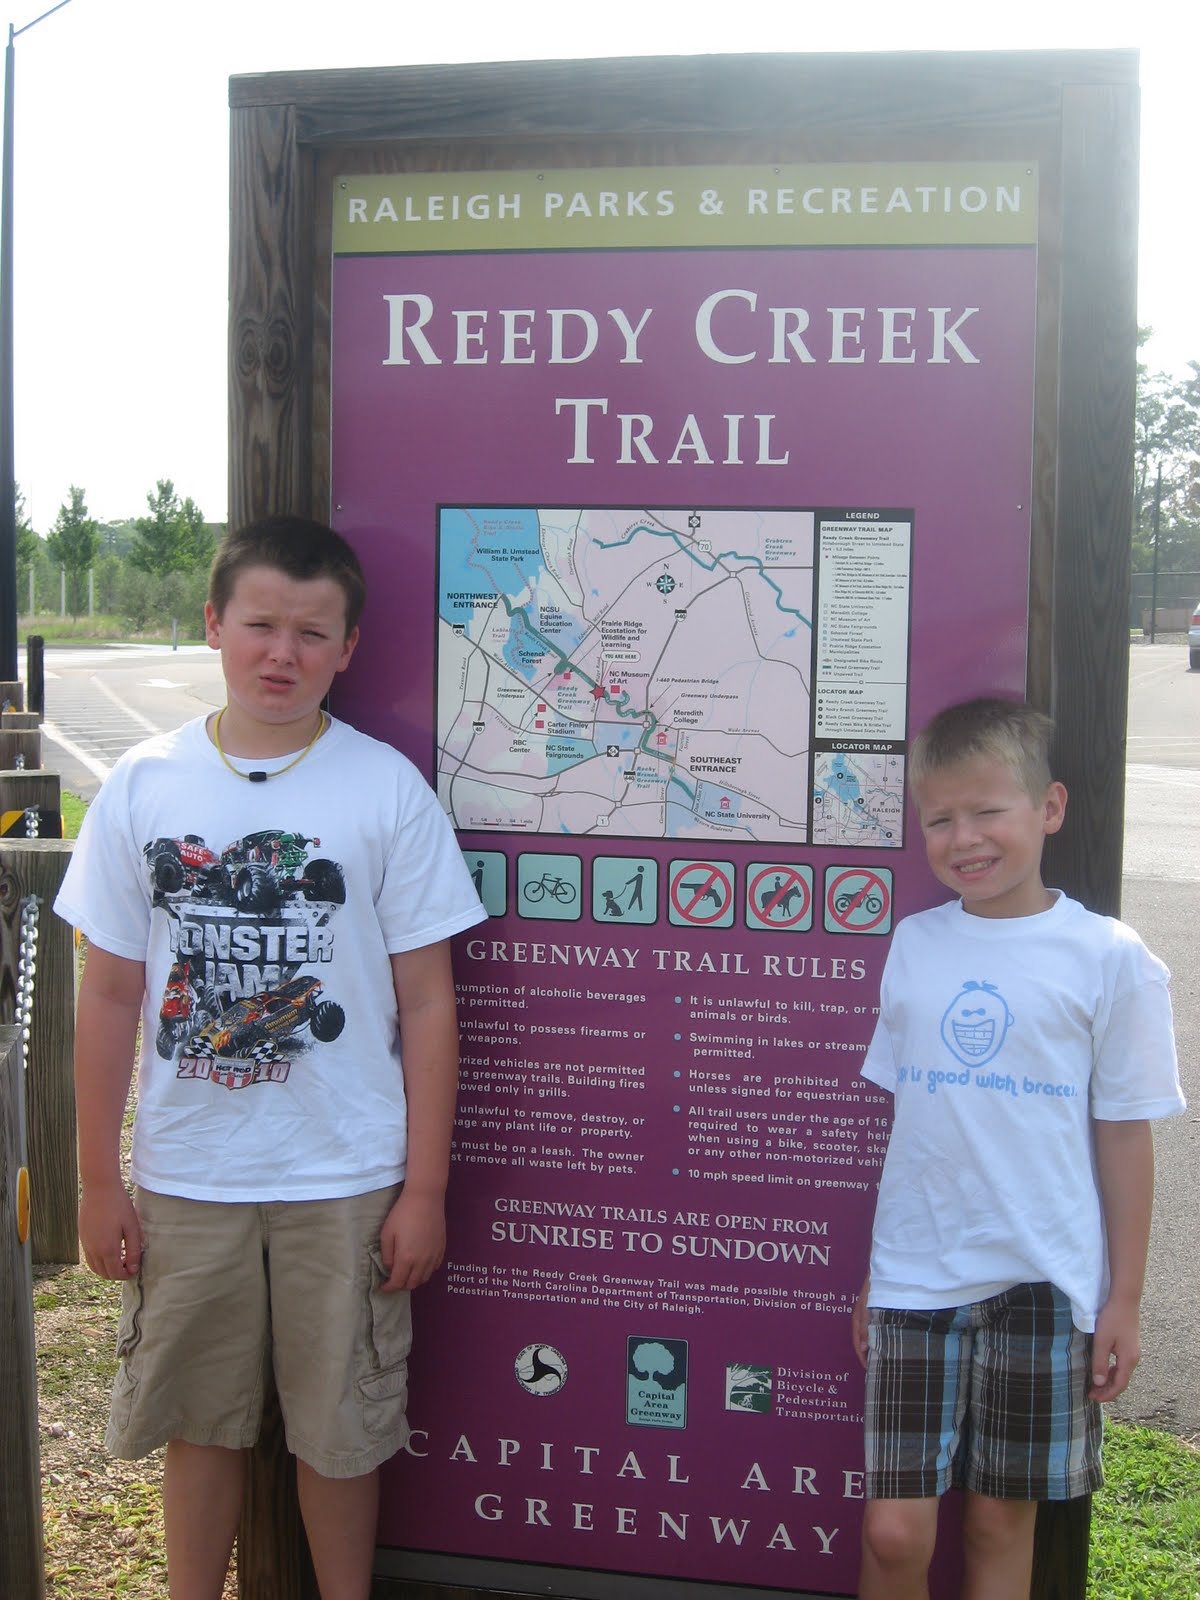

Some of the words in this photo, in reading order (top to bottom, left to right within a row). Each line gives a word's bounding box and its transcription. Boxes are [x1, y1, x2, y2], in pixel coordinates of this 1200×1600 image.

[348, 194, 521, 224] RALEIGH
[544, 189, 675, 219] PARKS
[699, 190, 725, 215] &
[747, 186, 1023, 216] RECREATION
[381, 292, 653, 366] REEDY
[695, 288, 980, 365] CREEK
[554, 396, 791, 467] TRAIL
[540, 613, 562, 621] Equine
[623, 621, 642, 629] Ridge
[570, 722, 588, 730] Finley
[690, 756, 742, 764] SOUTHEAST
[690, 765, 737, 773] ENTRANCE
[737, 812, 770, 820] University
[180, 850, 203, 861] AUTO
[181, 843, 204, 853] SAFE
[466, 940, 640, 969] GREENWAY
[653, 949, 749, 975] TRAIL
[763, 956, 867, 981] RULES
[470, 997, 528, 1009] permitted.
[514, 986, 526, 995] of
[530, 988, 582, 998] alcoholic
[587, 990, 646, 1003] beverages
[690, 996, 698, 1005] It
[704, 996, 713, 1006] is
[719, 998, 770, 1008] unlawful
[776, 1001, 787, 1010] to
[794, 1001, 815, 1012] kill,
[821, 1003, 848, 1014] trap,
[854, 1005, 866, 1014] or
[460, 1021, 509, 1030] unlawful
[514, 1024, 525, 1032] to
[530, 1025, 576, 1035] possess
[581, 1026, 628, 1038] firearms
[634, 1031, 646, 1039] or
[690, 1033, 753, 1047] Swimming
[758, 1036, 768, 1046] in
[774, 1037, 803, 1048] lakes
[808, 1041, 820, 1049] or
[177, 1058, 212, 1080] 20
[254, 1062, 290, 1083] 10
[473, 1070, 527, 1083] greenway
[531, 1073, 564, 1084] trails.
[568, 1076, 615, 1089] Building
[620, 1078, 645, 1089] fires
[928, 1069, 969, 1094] good
[976, 1074, 1018, 1097] with
[689, 1106, 704, 1115] All
[708, 1107, 732, 1118] trail
[736, 1110, 767, 1119] users
[772, 1113, 806, 1122] under
[810, 1115, 829, 1124] the
[833, 1117, 854, 1126] age
[858, 1117, 870, 1126] of
[875, 1118, 887, 1127] 16
[689, 1169, 699, 1178] 10
[704, 1170, 728, 1182] mph
[732, 1172, 764, 1183] speed
[768, 1174, 793, 1184] limit
[797, 1177, 810, 1185] on
[815, 1179, 869, 1191] greenway
[495, 1198, 596, 1218] GREENWAY
[600, 1206, 668, 1223] TRAILS
[673, 1211, 710, 1227] ARE
[715, 1215, 766, 1230] OPEN
[772, 1218, 828, 1235] FROM
[491, 1221, 614, 1250] SUNRISE
[622, 1231, 663, 1254] TO
[672, 1236, 831, 1266] SUNDOWN
[448, 1262, 488, 1274] Funding
[493, 1266, 506, 1274] for
[512, 1268, 528, 1276] the
[533, 1269, 564, 1280] Reedy
[569, 1272, 597, 1282] Creek
[603, 1275, 654, 1287] Greenway
[658, 1279, 679, 1288] Trail
[685, 1282, 705, 1291] was
[711, 1284, 739, 1293] made
[744, 1287, 788, 1298] possible
[793, 1289, 835, 1301] through
[777, 1367, 831, 1380] Division
[835, 1373, 849, 1381] of
[639, 1391, 674, 1400] Capital
[777, 1380, 824, 1393] Bicycle
[828, 1385, 837, 1394] &
[644, 1400, 668, 1409] Area
[777, 1394, 847, 1408] Pedestrian
[631, 1408, 681, 1420] Greenway
[404, 1429, 690, 1484] CAPITAL
[741, 1462, 865, 1499] ARE
[473, 1493, 839, 1555] GREENWAY
